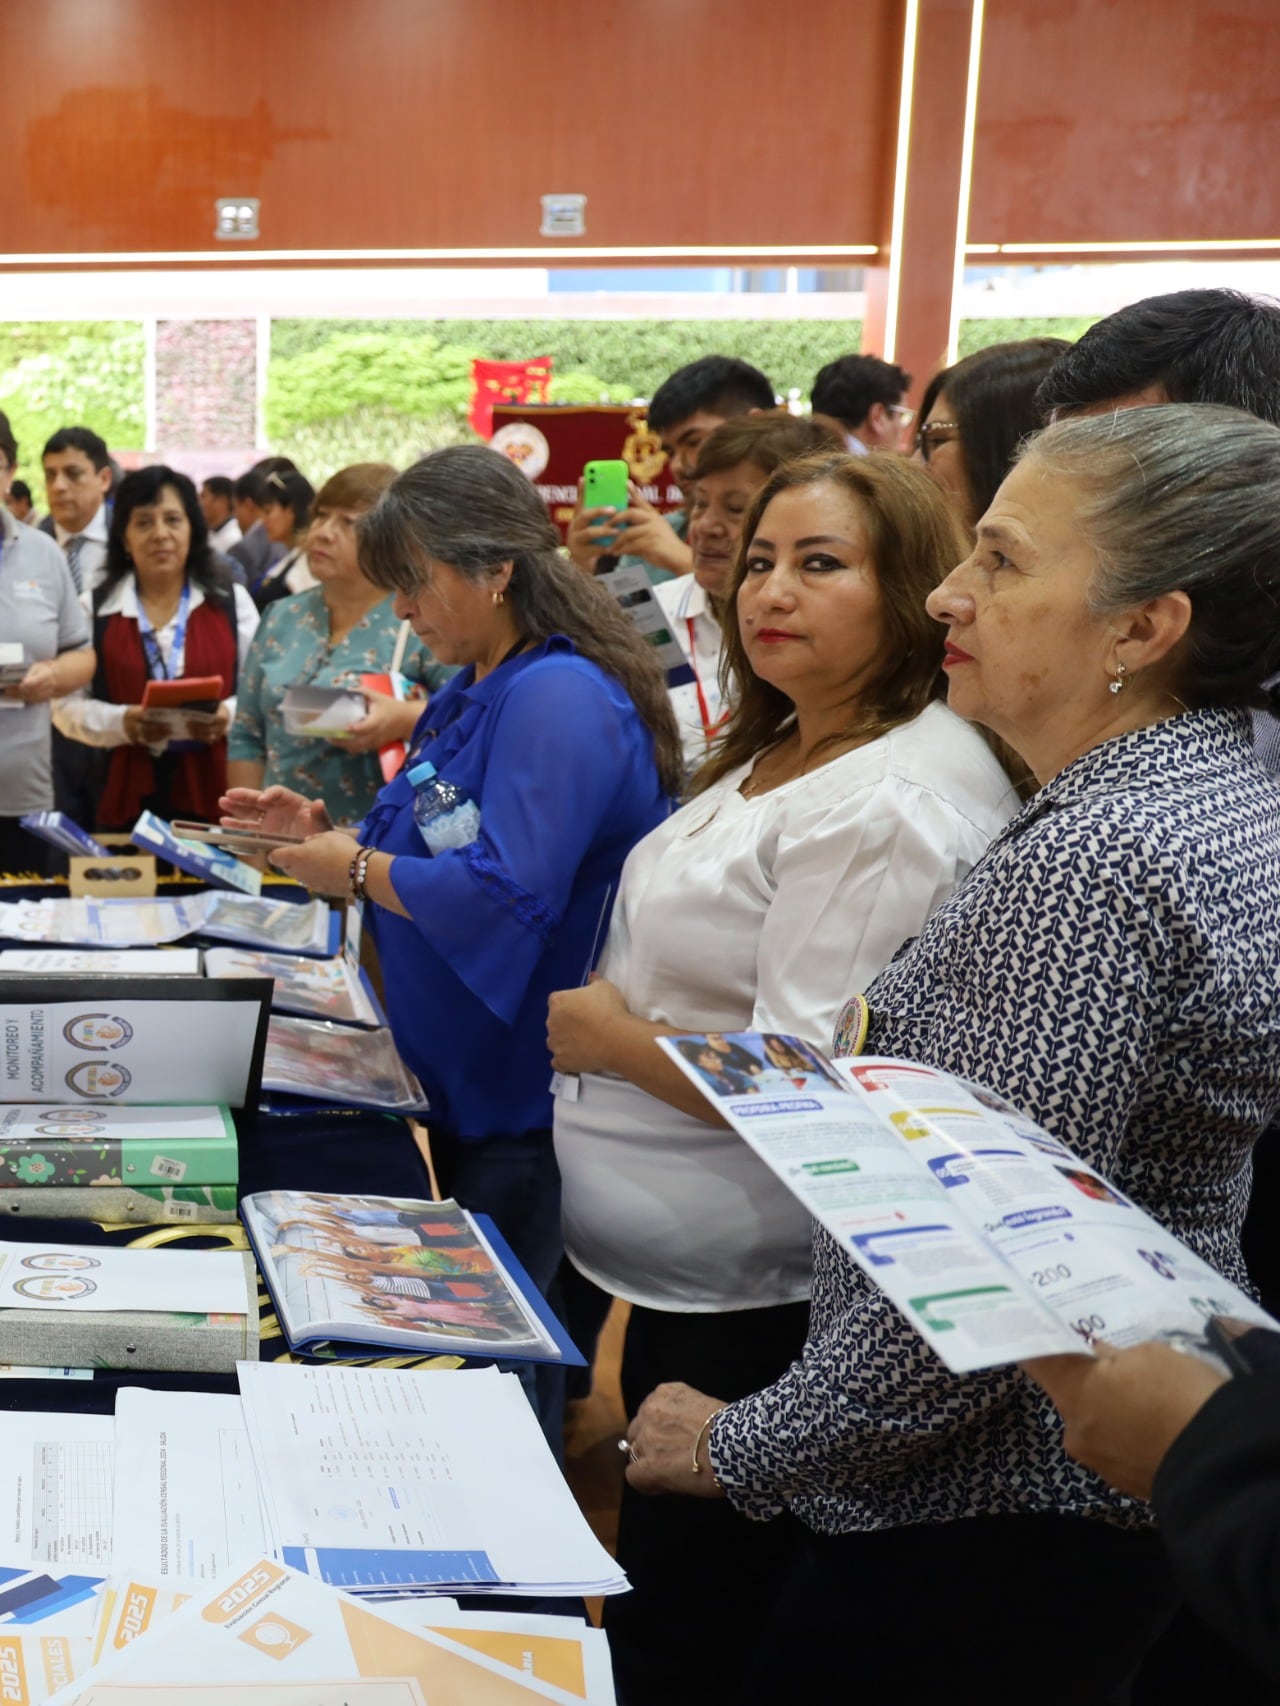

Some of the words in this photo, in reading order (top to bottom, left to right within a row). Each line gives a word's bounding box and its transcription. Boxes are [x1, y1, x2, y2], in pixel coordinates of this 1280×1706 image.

[5, 1023, 19, 1080] MONITOREO
[27, 1009, 45, 1093] ACOMPAÑAMIENTO
[160, 1543, 168, 1575] ESULTADOS
[120, 1592, 148, 1639] 2025
[218, 1568, 271, 1613] 2025
[224, 1607, 253, 1629] Evaluación
[251, 1591, 269, 1608] Censal
[267, 1575, 291, 1595] Regional
[0, 1645, 21, 1702] 2025
[48, 1640, 69, 1688] CIALES
